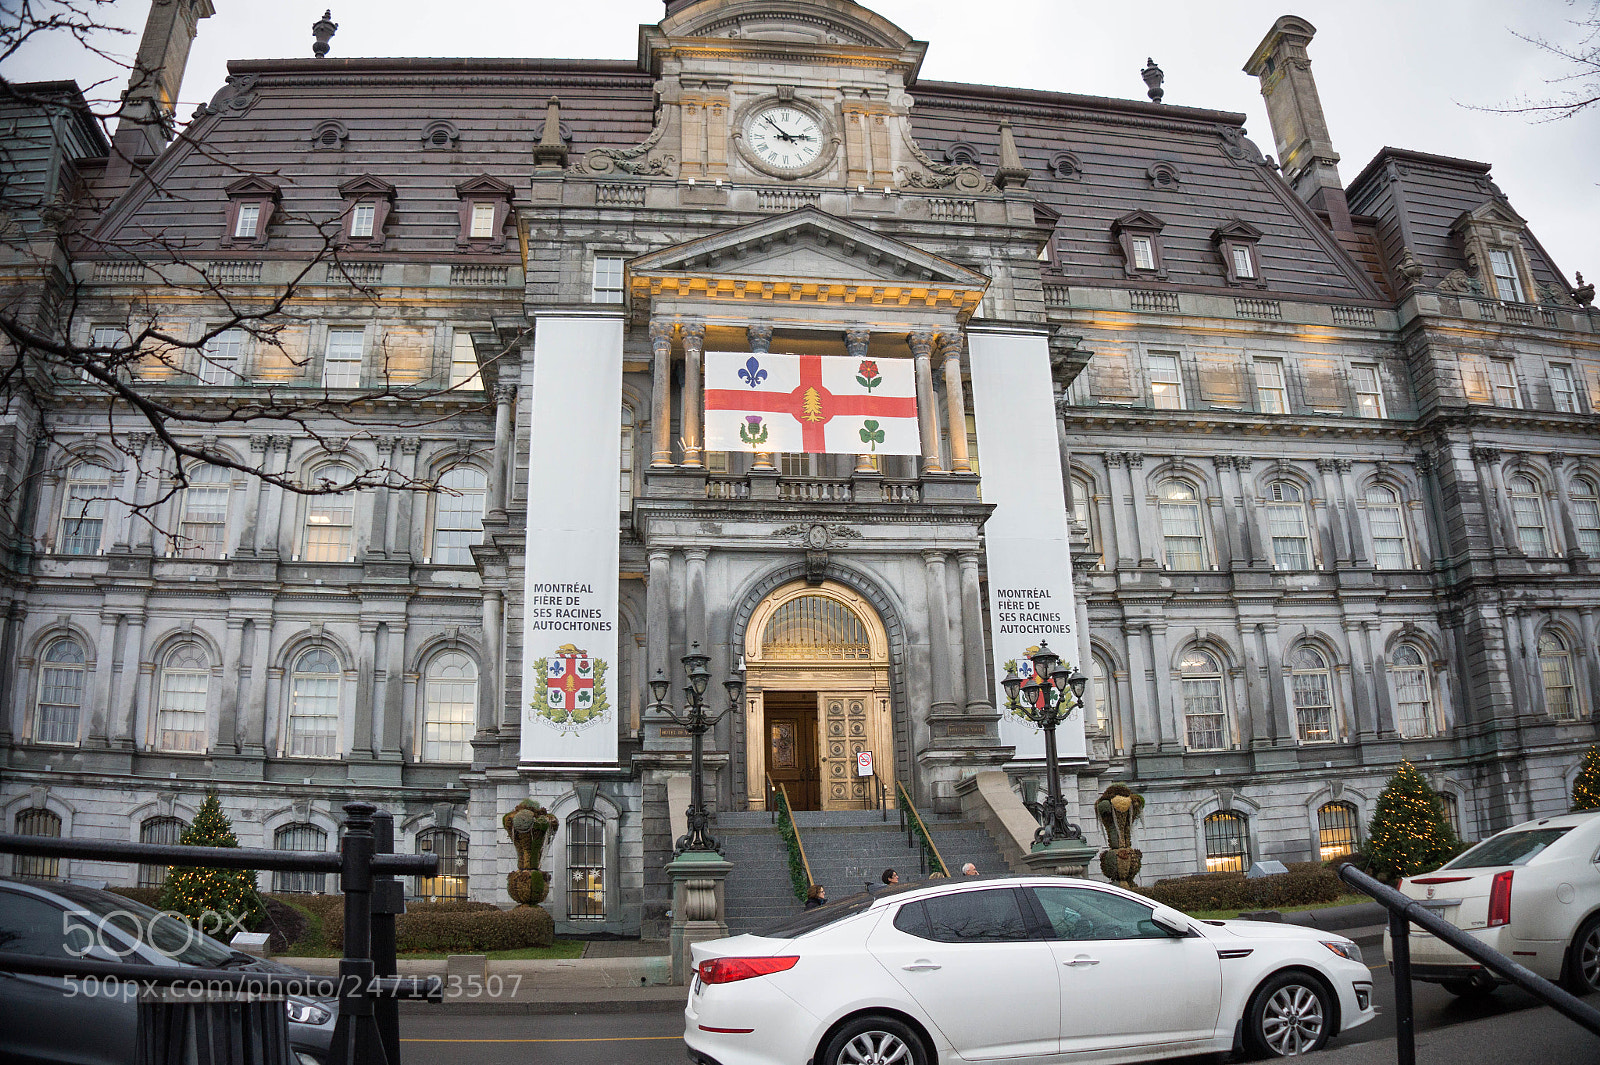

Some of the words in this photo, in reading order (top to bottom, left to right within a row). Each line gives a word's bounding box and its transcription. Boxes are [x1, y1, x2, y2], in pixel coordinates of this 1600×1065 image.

[534, 582, 594, 594] MONTRÉAL
[997, 587, 1052, 599] MONTRÉAL
[534, 594, 562, 606] FIÈRE
[566, 596, 580, 606] DE
[998, 599, 1024, 610] FIÈRE
[1027, 601, 1040, 610] DE
[533, 608, 552, 618] SES
[555, 609, 602, 619] RACINES
[999, 612, 1017, 622] SES
[1019, 613, 1061, 622] RACINES
[533, 621, 612, 631] AUTOCHTONES
[1000, 624, 1071, 634] AUTOCHTONES
